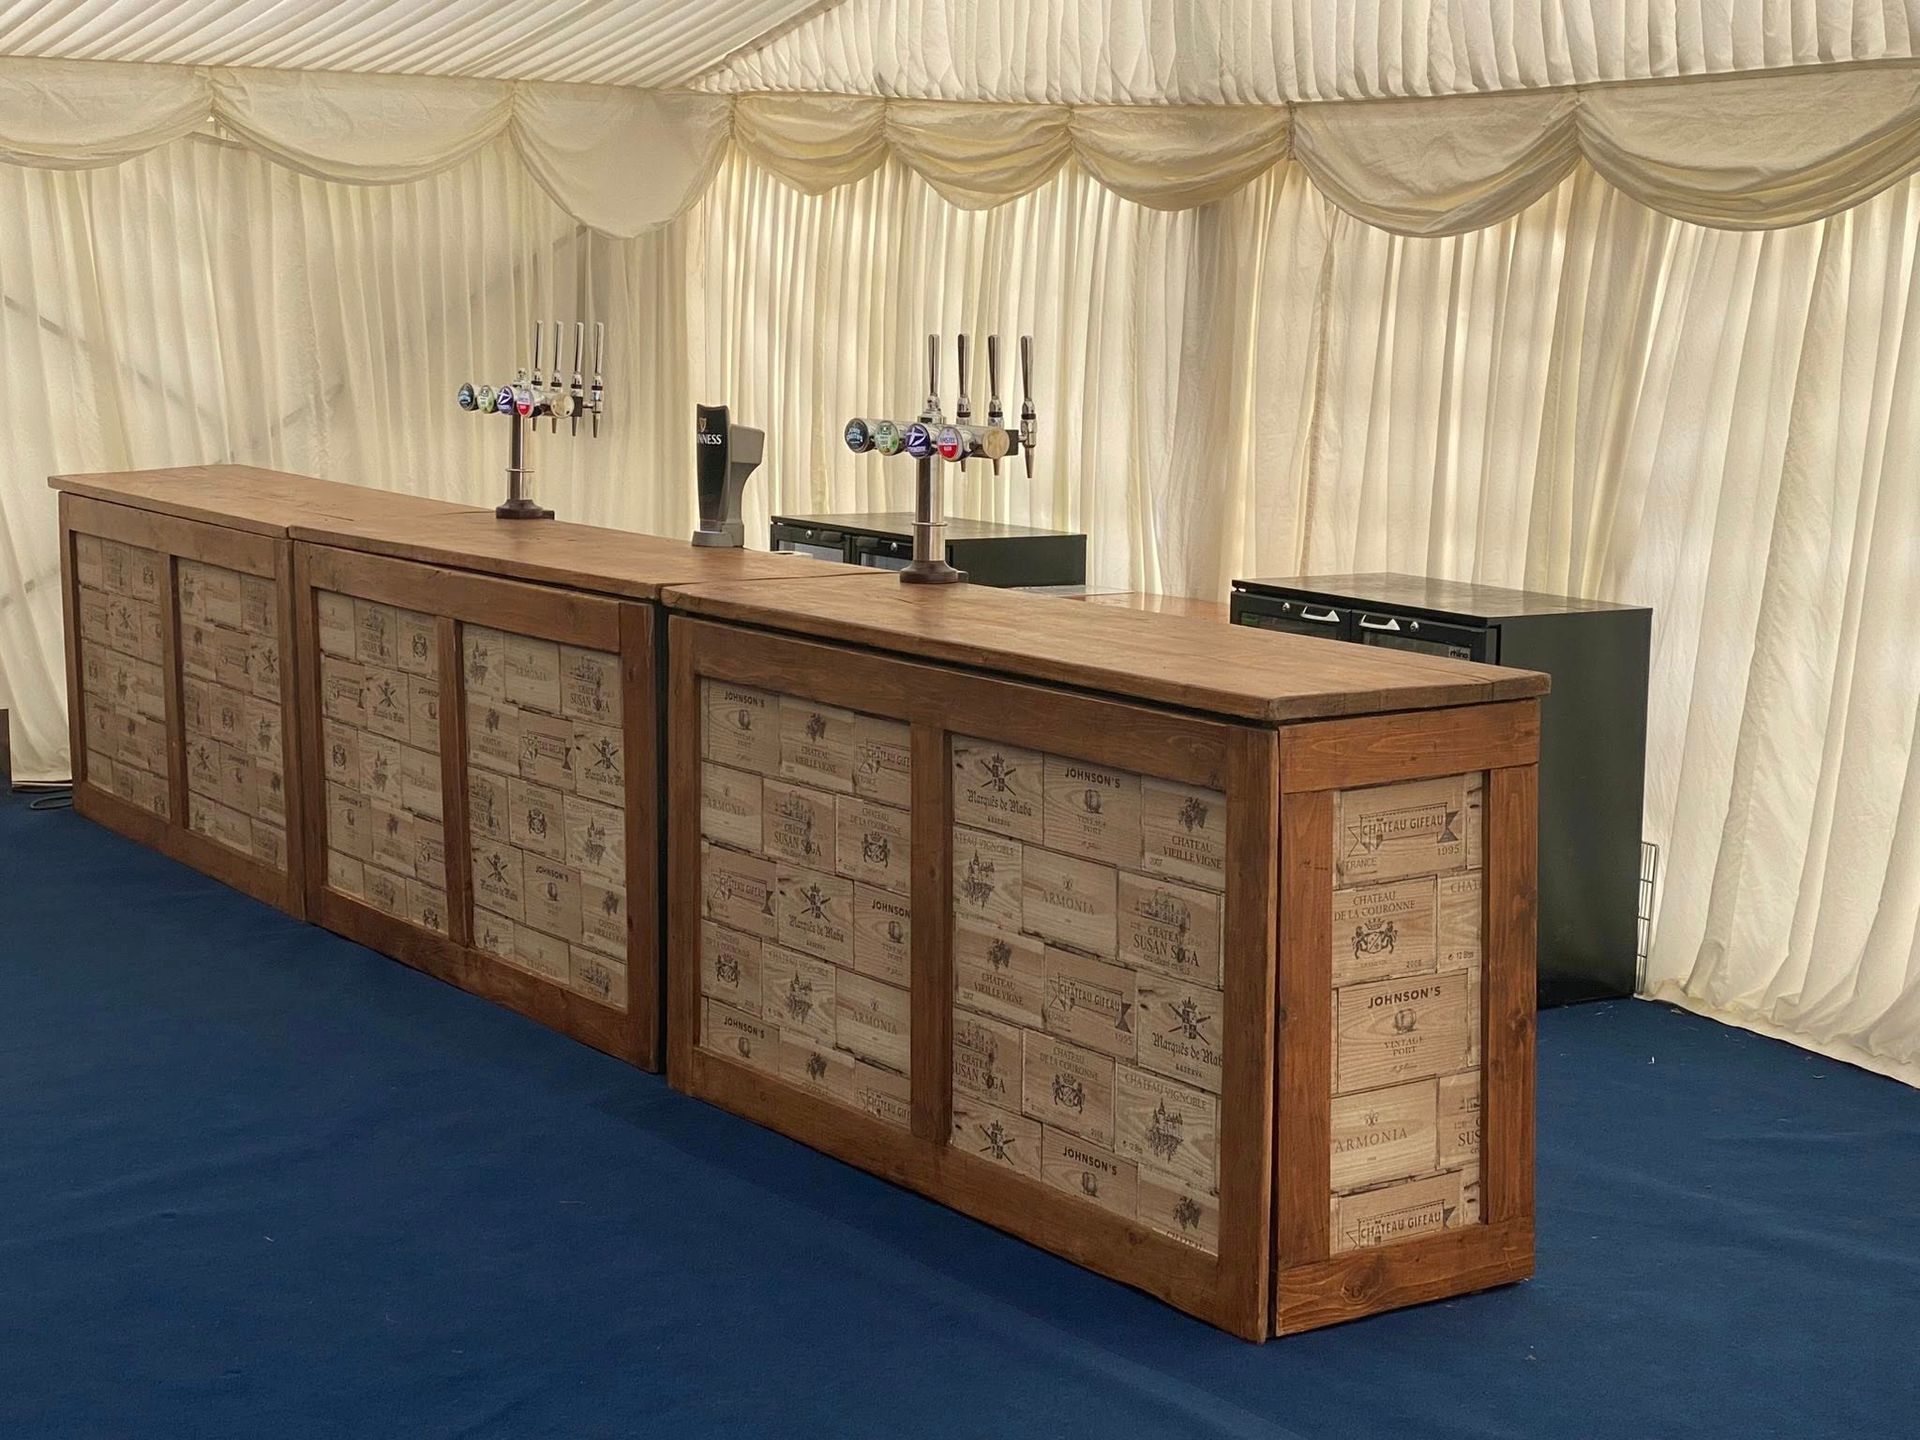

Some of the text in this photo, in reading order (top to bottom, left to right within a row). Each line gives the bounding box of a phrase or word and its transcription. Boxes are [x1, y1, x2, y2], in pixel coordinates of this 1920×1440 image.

[724, 690, 765, 708] JOHNSON'S
[1064, 767, 1121, 789] JOHNSON'S
[1409, 814, 1445, 830] GIFEAU
[1172, 835, 1213, 853] CHATEAU
[1437, 845, 1460, 857] 1995
[1042, 891, 1095, 916] ARMONIA
[1353, 890, 1397, 907] CHATEAU
[1334, 900, 1416, 922] DE LA COURONNE
[1133, 933, 1168, 956] SUSAN
[1367, 986, 1441, 1010] JOHNSON'S
[724, 1016, 765, 1039] JOHNSON'S
[852, 1010, 897, 1035] ARMONIA
[1383, 1035, 1424, 1050] VINTAGE
[1392, 1045, 1417, 1057] PORT
[1190, 1045, 1200, 1062] de
[1334, 1127, 1409, 1154] ARMONIA
[1063, 1146, 1118, 1176] JOHNSON'S
[1407, 1211, 1442, 1230] GIFEAU
